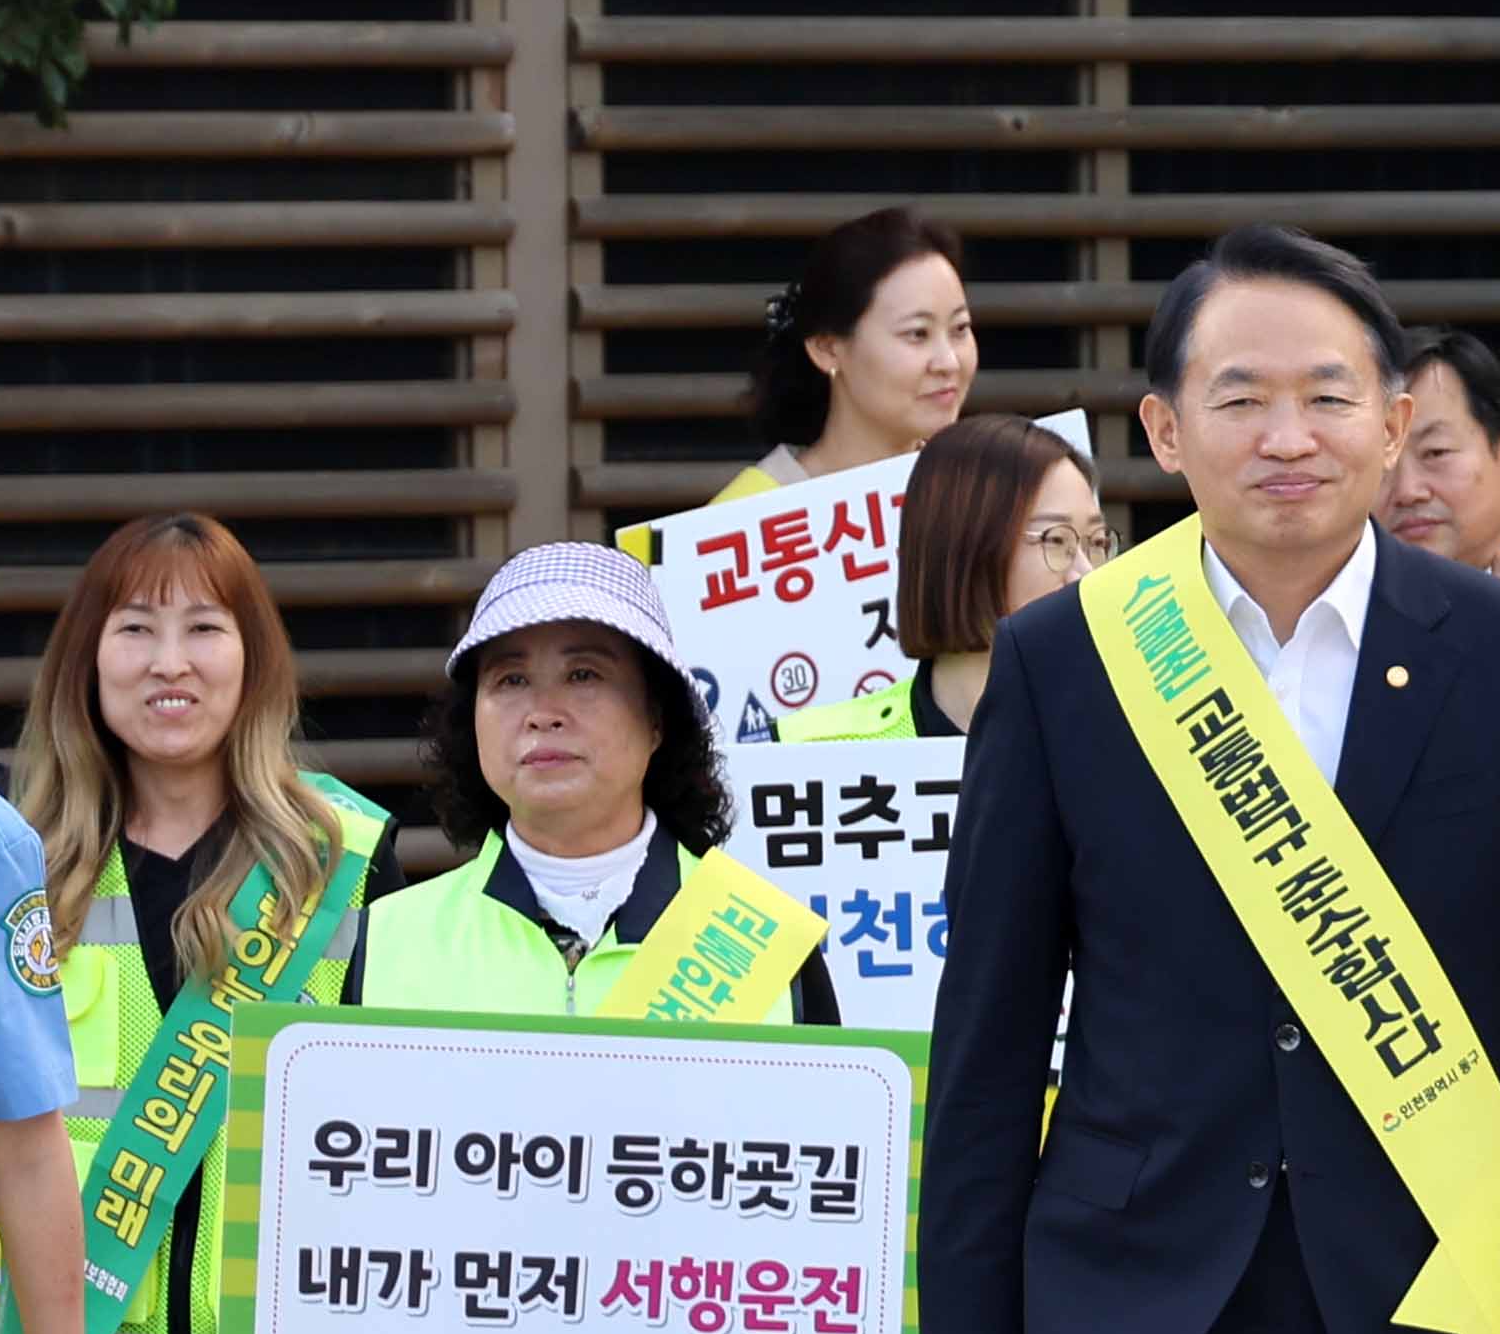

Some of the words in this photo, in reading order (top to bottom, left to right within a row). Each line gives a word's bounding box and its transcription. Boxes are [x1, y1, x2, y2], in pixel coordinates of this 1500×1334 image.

[696, 491, 906, 611] 교통신
[781, 664, 808, 690] 30
[1123, 574, 1211, 702] 스쿨존
[1175, 686, 1313, 867] 교통법규
[1276, 856, 1444, 1080] 준수합시다
[645, 893, 779, 1021] 교통안
[134, 1019, 231, 1156] 우리의
[1400, 1068, 1459, 1119] 인천광역시
[1458, 1049, 1479, 1075] 동구
[95, 1148, 165, 1248] 미래
[308, 1120, 431, 1191] 우리
[454, 1132, 585, 1194] 아이
[606, 1135, 860, 1216] 등하굣길
[84, 1259, 129, 1302] 보험협회
[299, 1247, 432, 1309] 내가
[454, 1255, 580, 1319] 먼저
